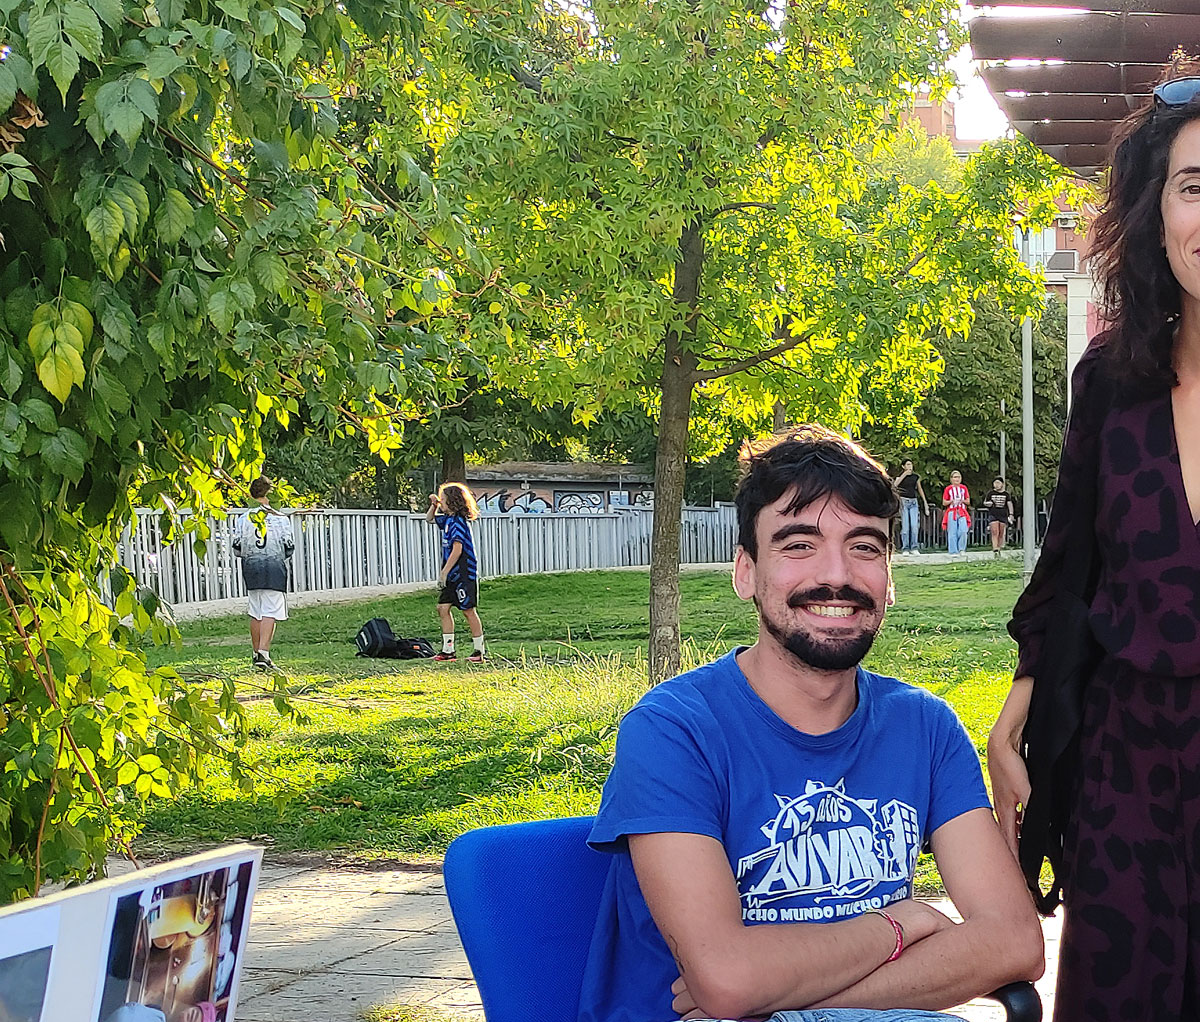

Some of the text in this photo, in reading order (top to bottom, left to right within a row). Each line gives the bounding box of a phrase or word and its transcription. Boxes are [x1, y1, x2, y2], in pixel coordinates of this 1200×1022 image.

[782, 800, 816, 838] 15
[742, 908, 778, 921] CHO
[780, 906, 834, 921] MUNDO
[836, 897, 881, 917] MUCHO
